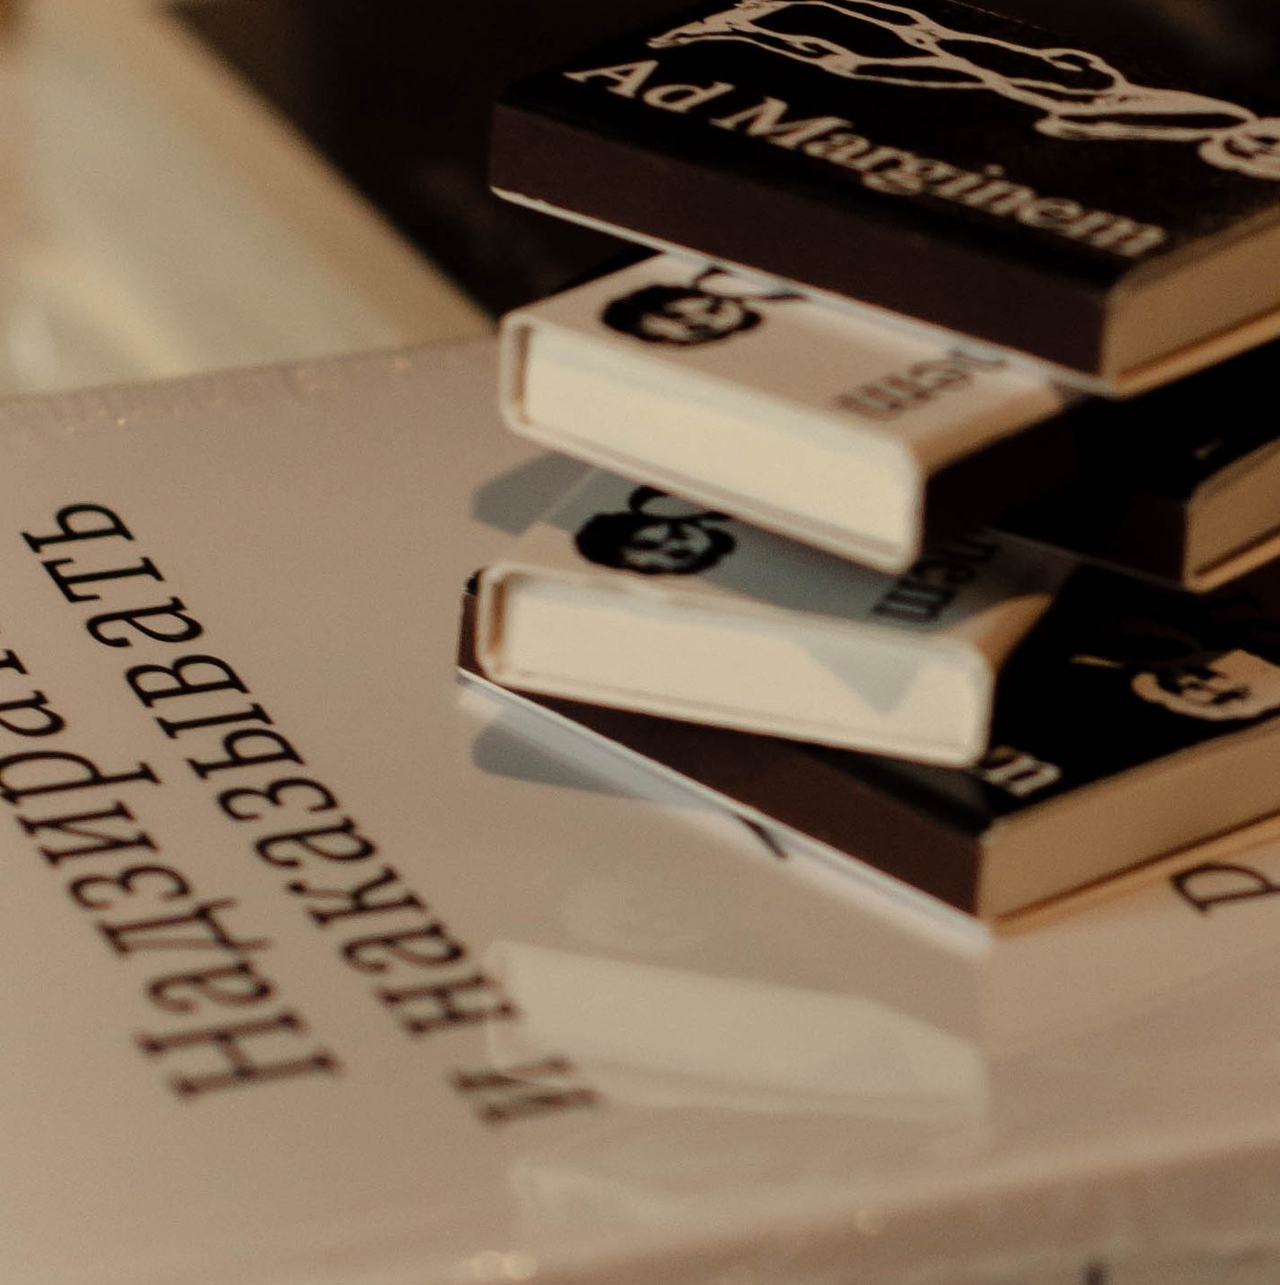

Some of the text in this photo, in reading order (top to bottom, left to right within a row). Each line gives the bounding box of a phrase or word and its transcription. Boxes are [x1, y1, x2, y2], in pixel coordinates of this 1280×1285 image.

[564, 59, 1166, 258] Ad Marginem
[0, 648, 346, 1103] Надзира
[20, 501, 520, 1038] наказывать
[448, 1056, 604, 1127] и
